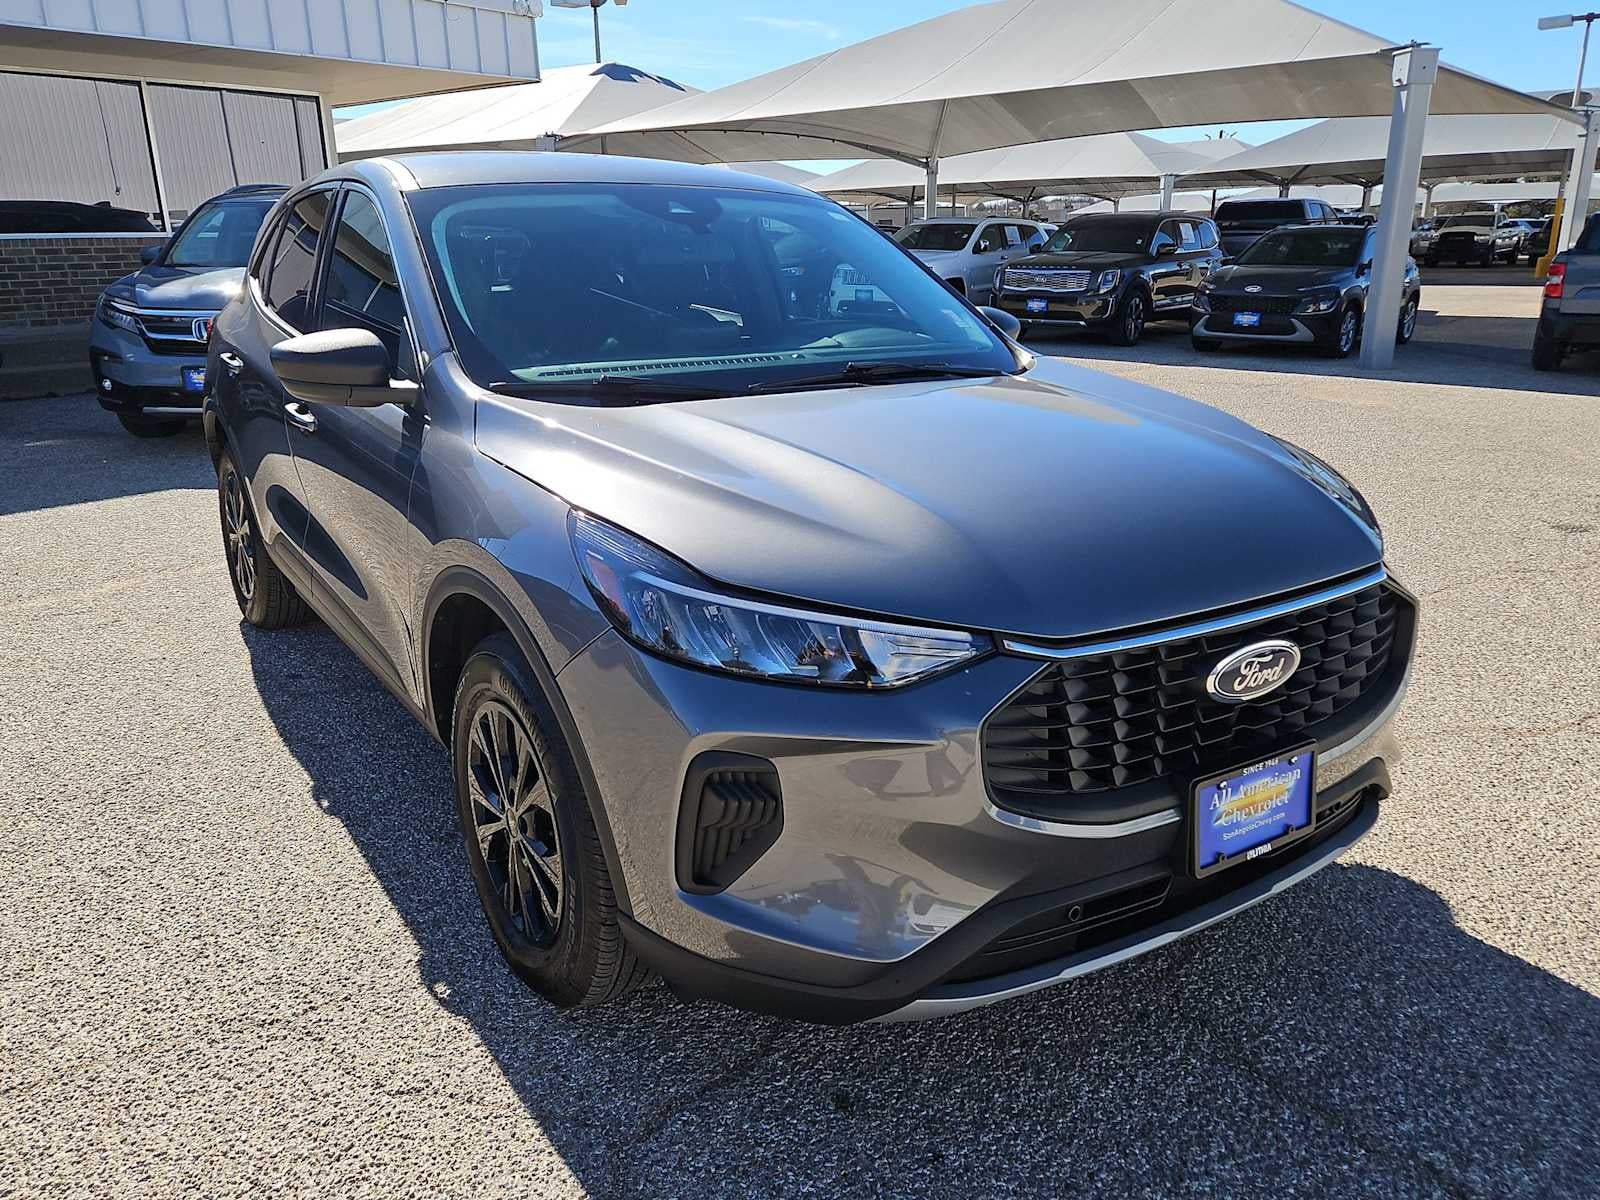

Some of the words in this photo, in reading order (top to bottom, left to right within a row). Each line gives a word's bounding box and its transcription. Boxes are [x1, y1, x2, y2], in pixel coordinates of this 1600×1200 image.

[1233, 654, 1285, 691] Ford
[1242, 761, 1264, 777] SINCE
[1209, 787, 1233, 810] All
[1238, 768, 1301, 799] American
[1221, 792, 1289, 826] Chevrolet
